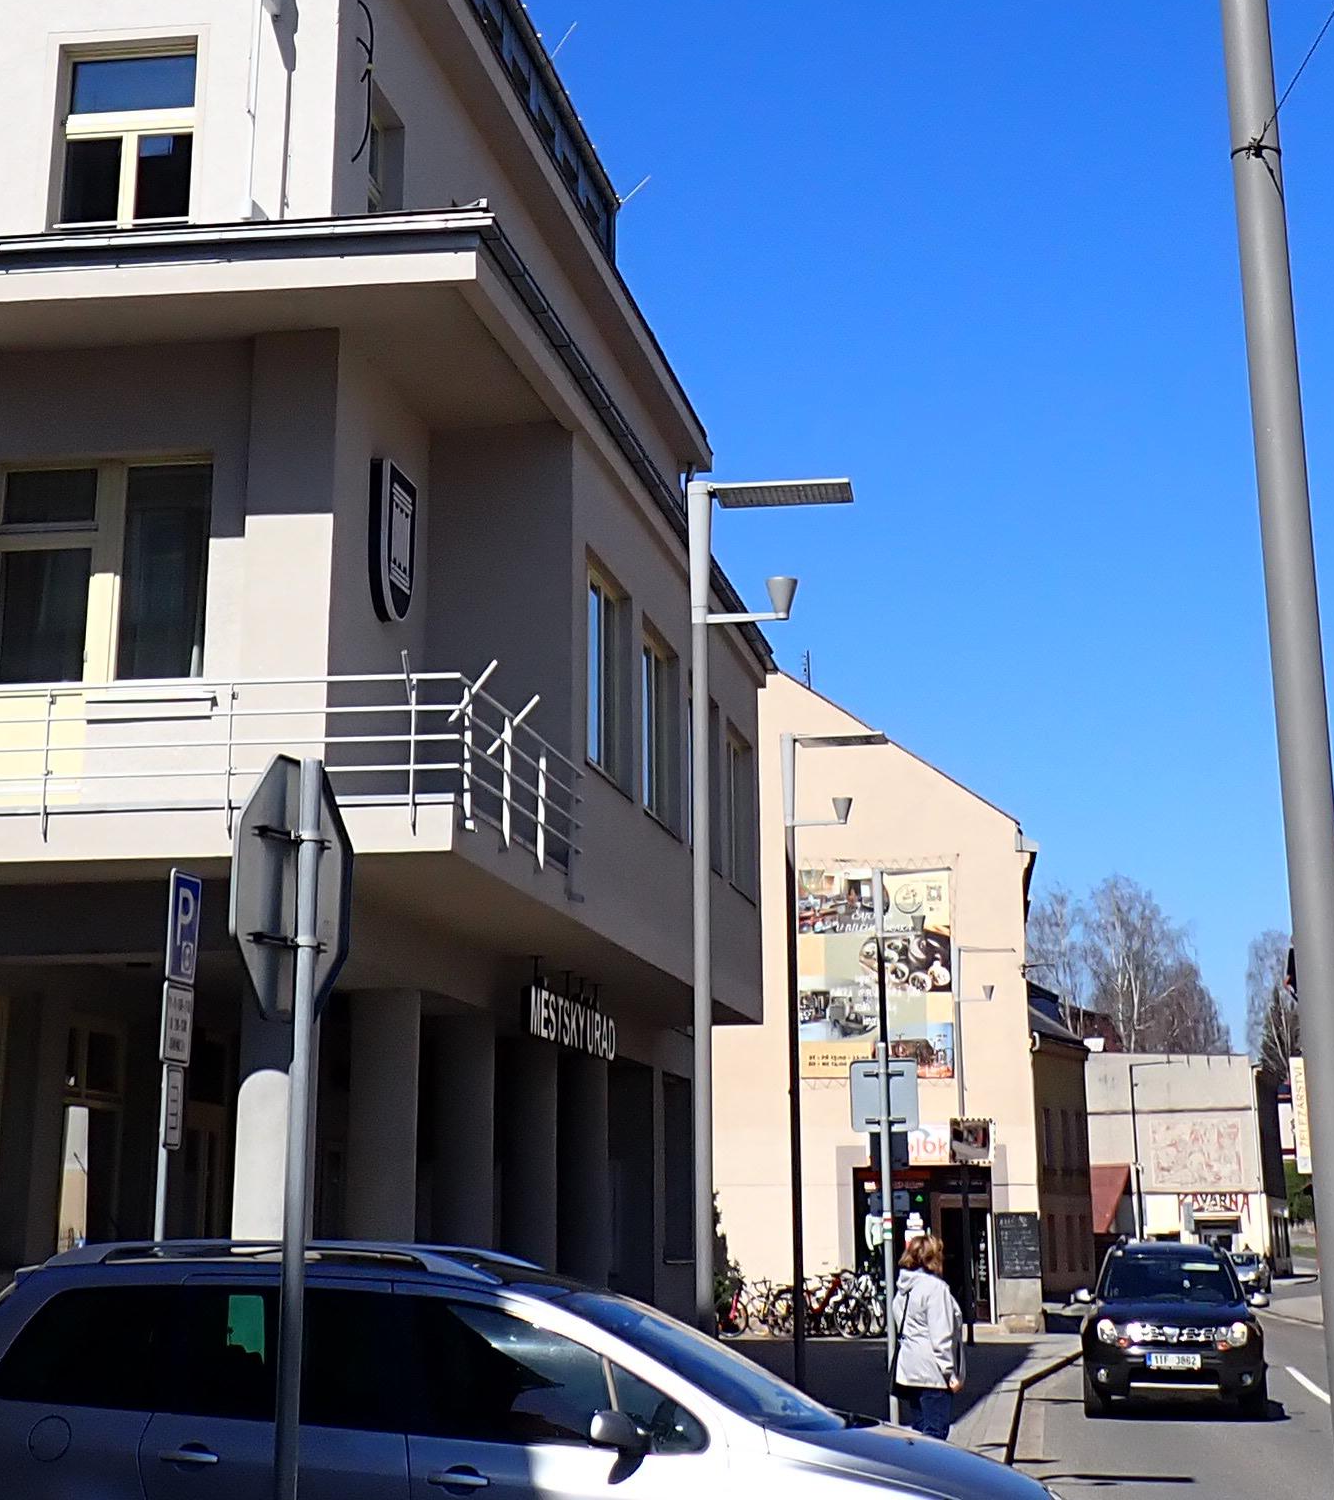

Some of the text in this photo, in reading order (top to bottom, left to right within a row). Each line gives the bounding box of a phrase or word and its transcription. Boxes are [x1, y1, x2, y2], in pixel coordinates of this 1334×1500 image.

[176, 886, 195, 946] P
[530, 977, 616, 1061] MĚSTSKÝ ÚŘAD
